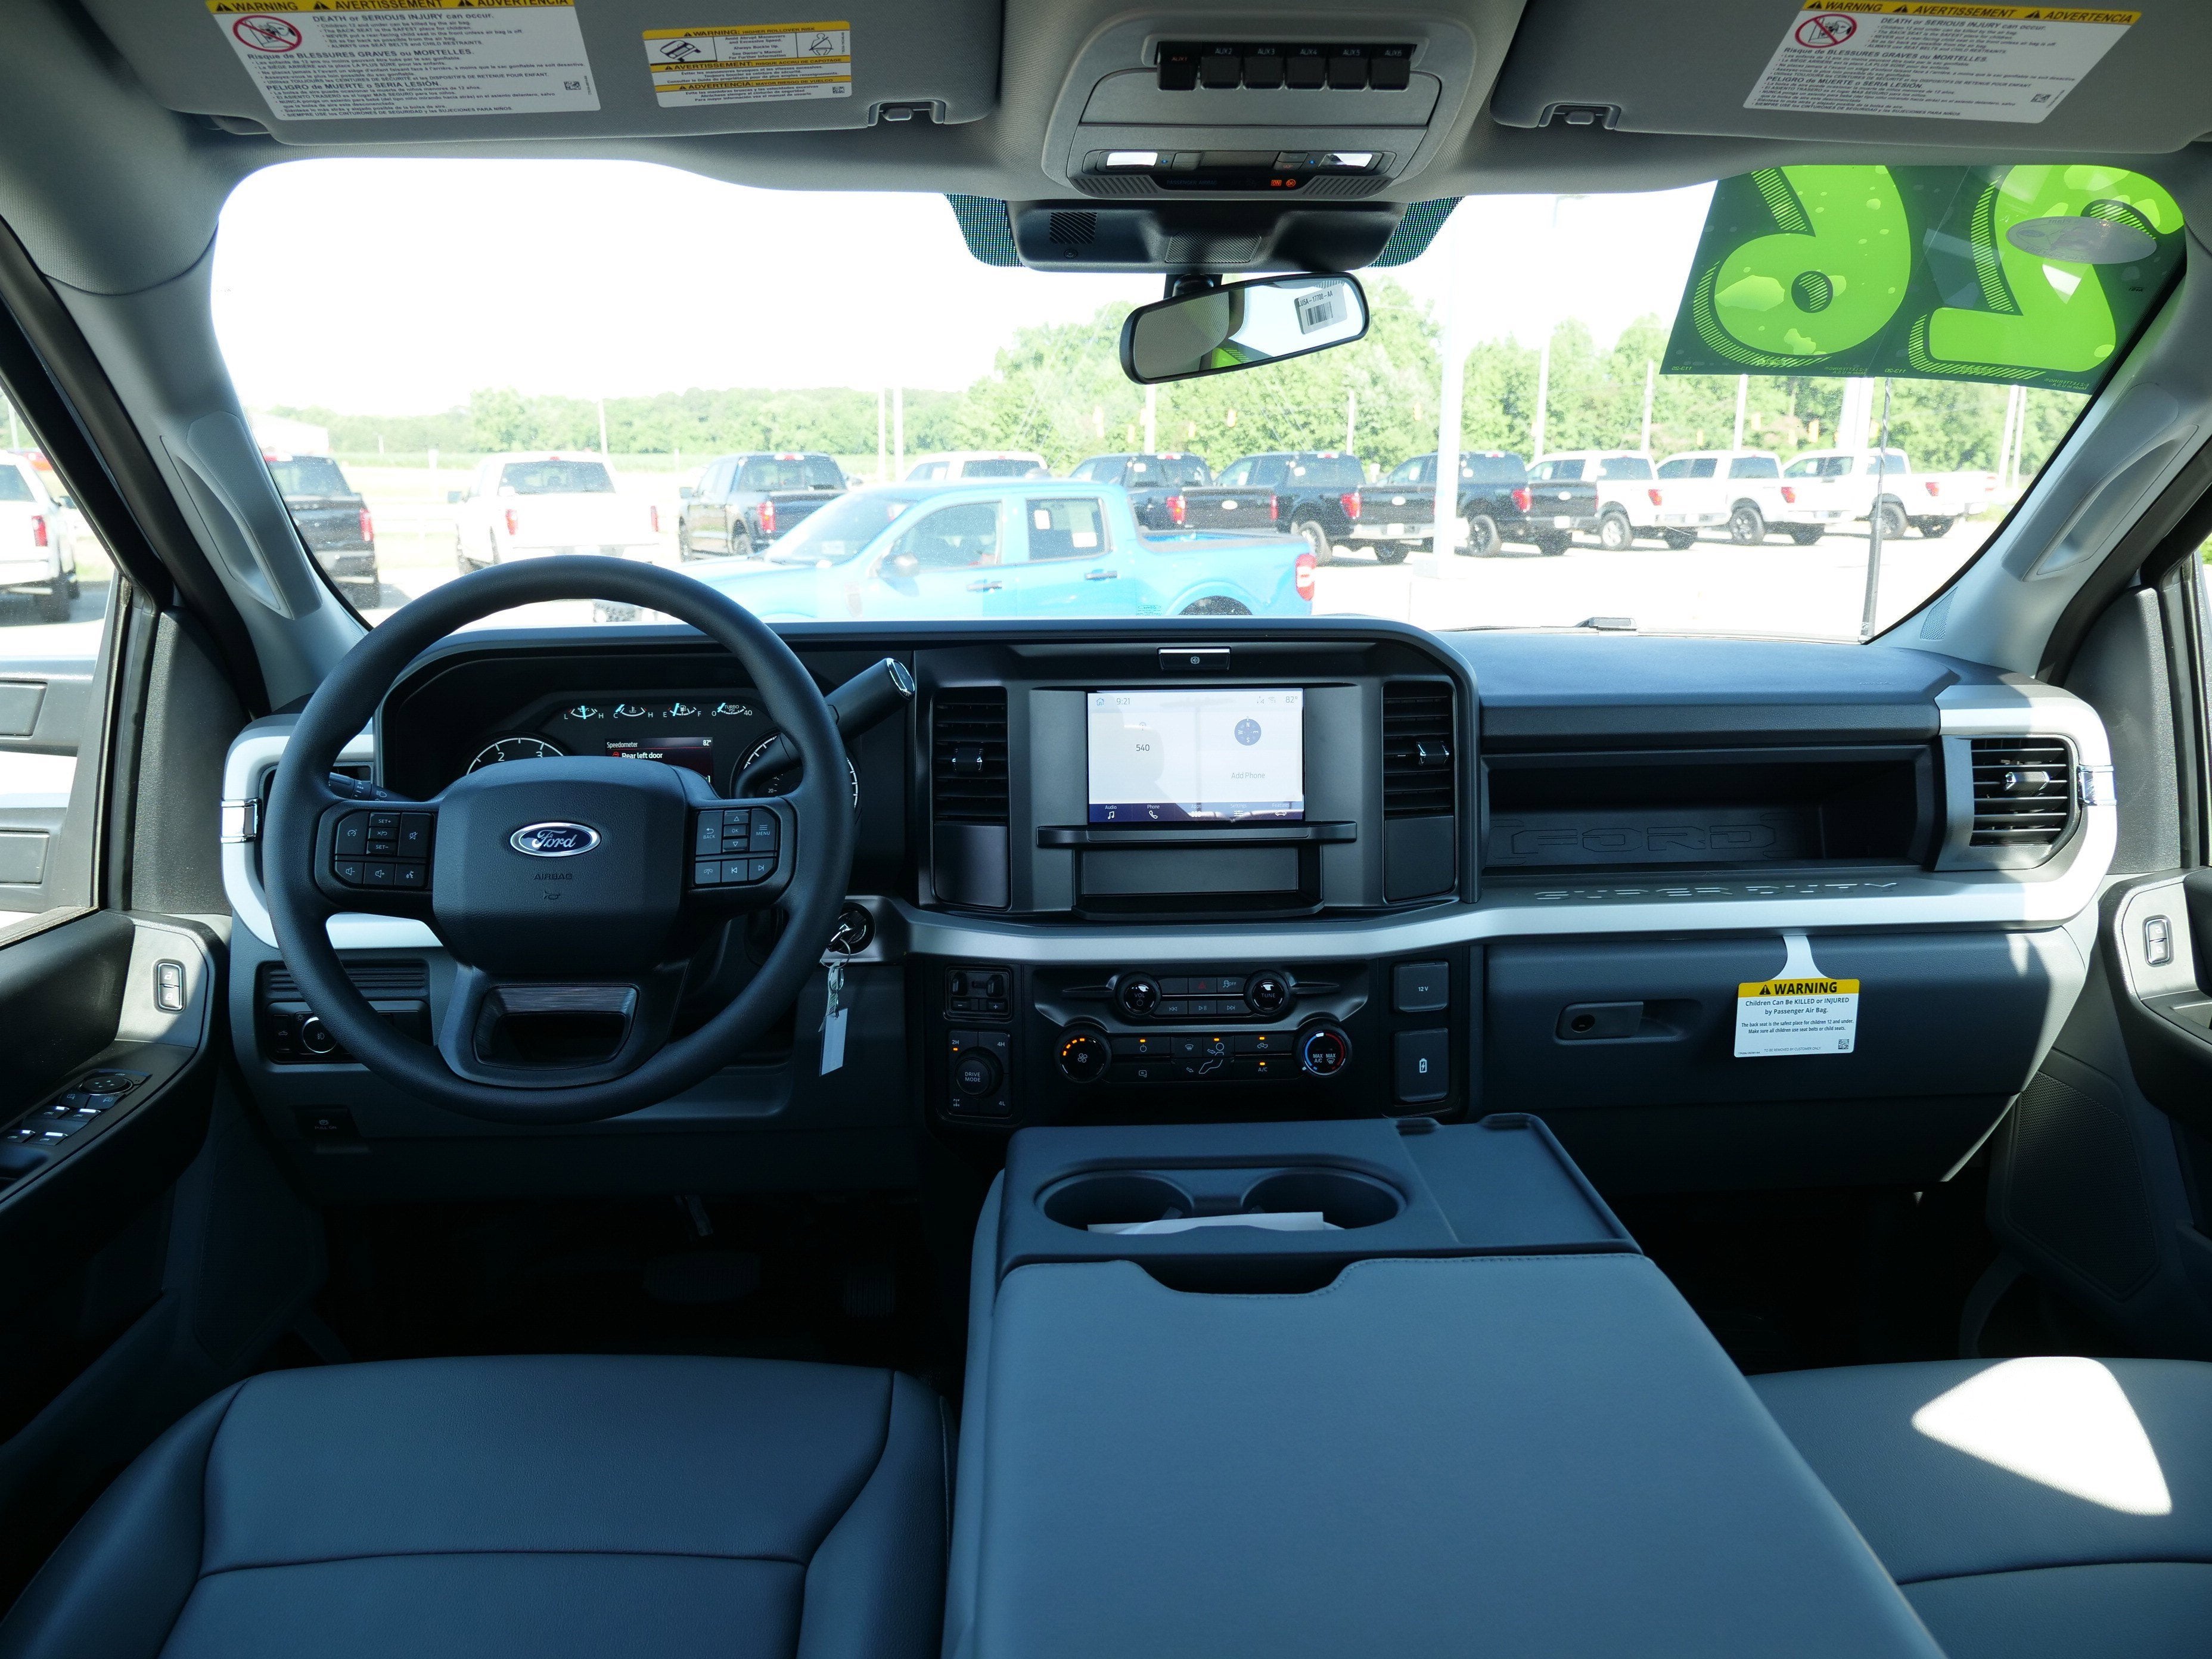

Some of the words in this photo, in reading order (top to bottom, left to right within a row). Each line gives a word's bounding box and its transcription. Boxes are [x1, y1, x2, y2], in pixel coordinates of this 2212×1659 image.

[232, 2, 298, 11] WARNING
[335, 0, 442, 10] AVERTISSEMENT
[1825, 2, 1882, 12] WARNING
[1913, 5, 2017, 17] AVERTISSEMENT
[2044, 11, 2133, 23] ADVERTENCIA
[674, 61, 753, 70] AVERTISSEMENT:
[688, 81, 754, 89] ADVERTENCIA:
[498, 752, 505, 761] 2
[532, 829, 576, 849] Ford
[1511, 824, 1776, 854] FORD
[1774, 982, 1837, 995] WARNING
